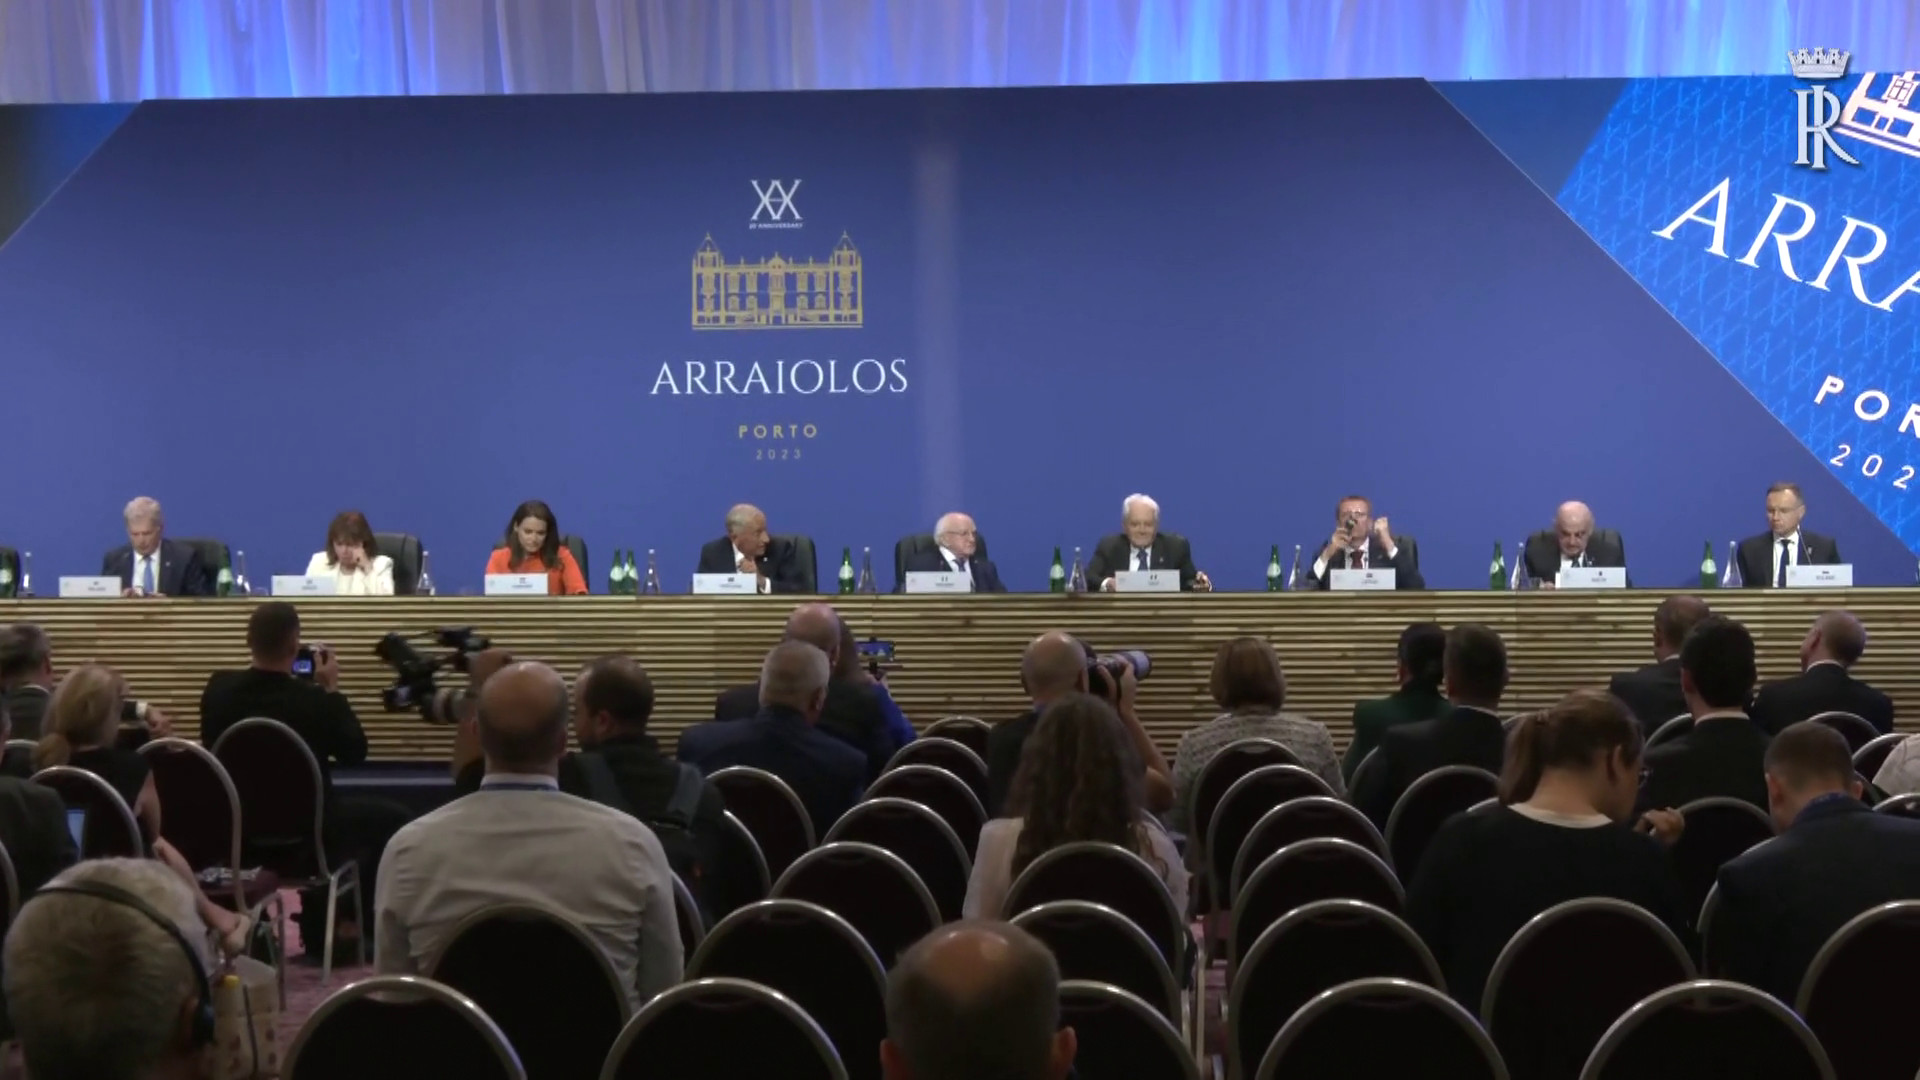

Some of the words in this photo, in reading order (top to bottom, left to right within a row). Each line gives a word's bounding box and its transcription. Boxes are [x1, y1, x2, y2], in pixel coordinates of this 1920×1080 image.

[650, 359, 908, 395] ARRAIOLOS
[738, 424, 817, 439] PORTO
[756, 448, 801, 461] 2023
[1829, 444, 1915, 490] 202
